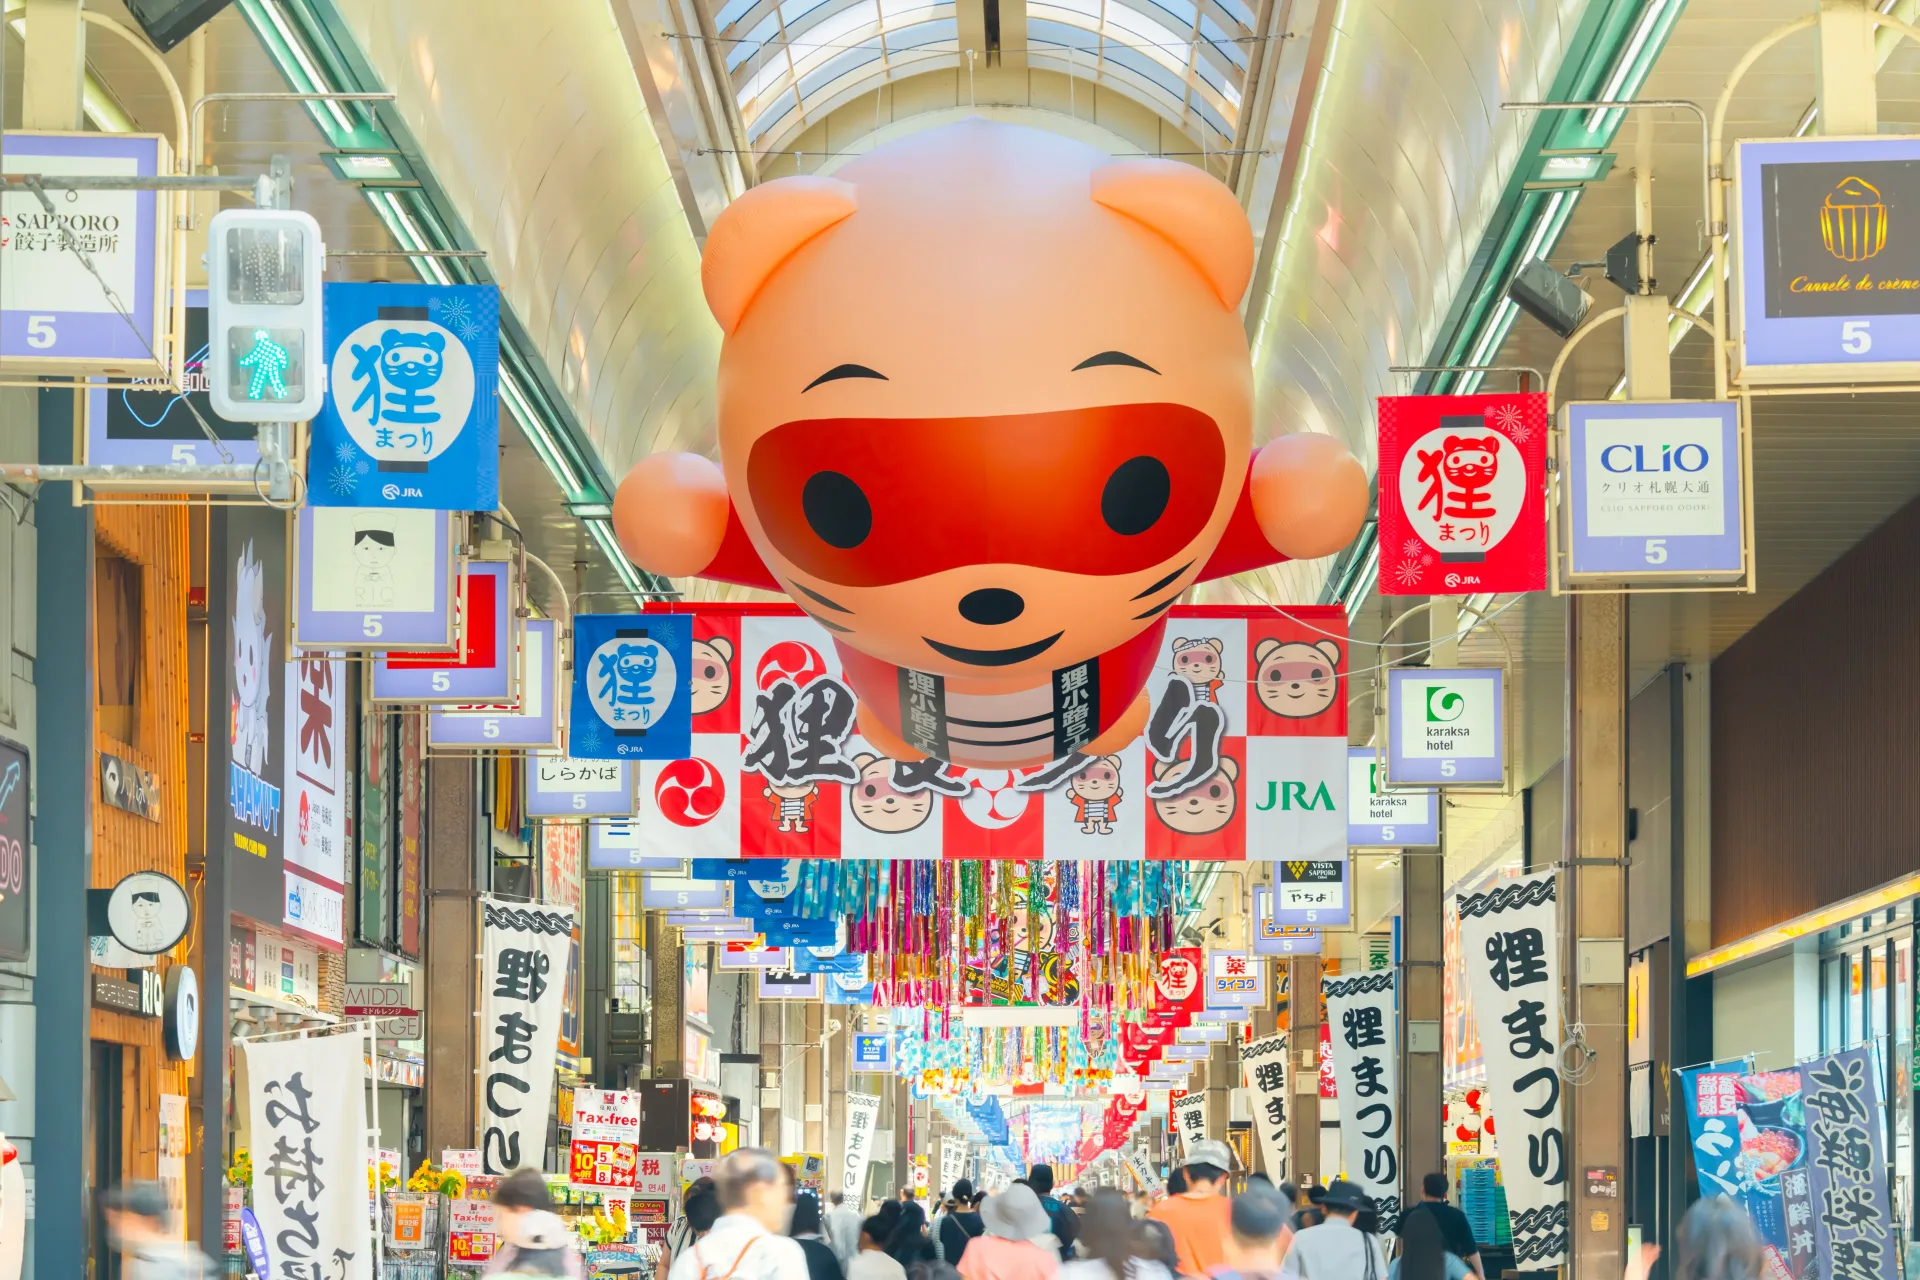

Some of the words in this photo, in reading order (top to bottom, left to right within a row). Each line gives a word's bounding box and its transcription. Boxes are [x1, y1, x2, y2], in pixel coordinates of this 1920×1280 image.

[15, 213, 119, 231] SAPPORO
[14, 232, 119, 254] 餃子製造所
[1790, 273, 1851, 293] Cannelé
[1855, 272, 1874, 291] de
[1878, 277, 1920, 290] crème
[27, 316, 57, 349] 5
[1841, 321, 1872, 354] 5
[375, 427, 434, 456] まつり
[401, 487, 423, 498] JRA
[1601, 480, 1710, 494] クリオ札幌大通
[1438, 521, 1491, 545] まつり
[1644, 539, 1668, 564] 5
[1461, 574, 1481, 585] JRA
[363, 614, 383, 637] 5
[432, 671, 450, 692] 5
[614, 708, 651, 726] まつり
[483, 719, 500, 738] 5
[1426, 726, 1470, 737] karaksa
[1426, 740, 1454, 751] hotel
[541, 766, 618, 781] しらかば
[1440, 759, 1457, 777] 5
[573, 794, 587, 810] 5
[1255, 780, 1336, 811] JRA
[1369, 797, 1407, 806] karaksa
[1369, 809, 1393, 818] hotel
[1381, 826, 1395, 840] 5
[677, 891, 689, 904] 5
[762, 884, 787, 896] まつり
[1290, 893, 1327, 902] やちよ
[1306, 909, 1317, 921] 5
[1283, 940, 1292, 951] 5
[749, 952, 758, 963] 5
[1226, 955, 1247, 975] 薬
[784, 985, 793, 995] 5
[1217, 979, 1256, 989] ダイコク
[1232, 994, 1241, 1003] 5
[1486, 926, 1564, 1187] 狸まつり
[1342, 1006, 1397, 1185] 狸まつり
[576, 1110, 638, 1126] Tax-free
[444, 1161, 480, 1169] Tax-free
[574, 1152, 594, 1170] 10
[648, 1183, 666, 1193] 면세
[453, 1213, 495, 1223] Tax-free
